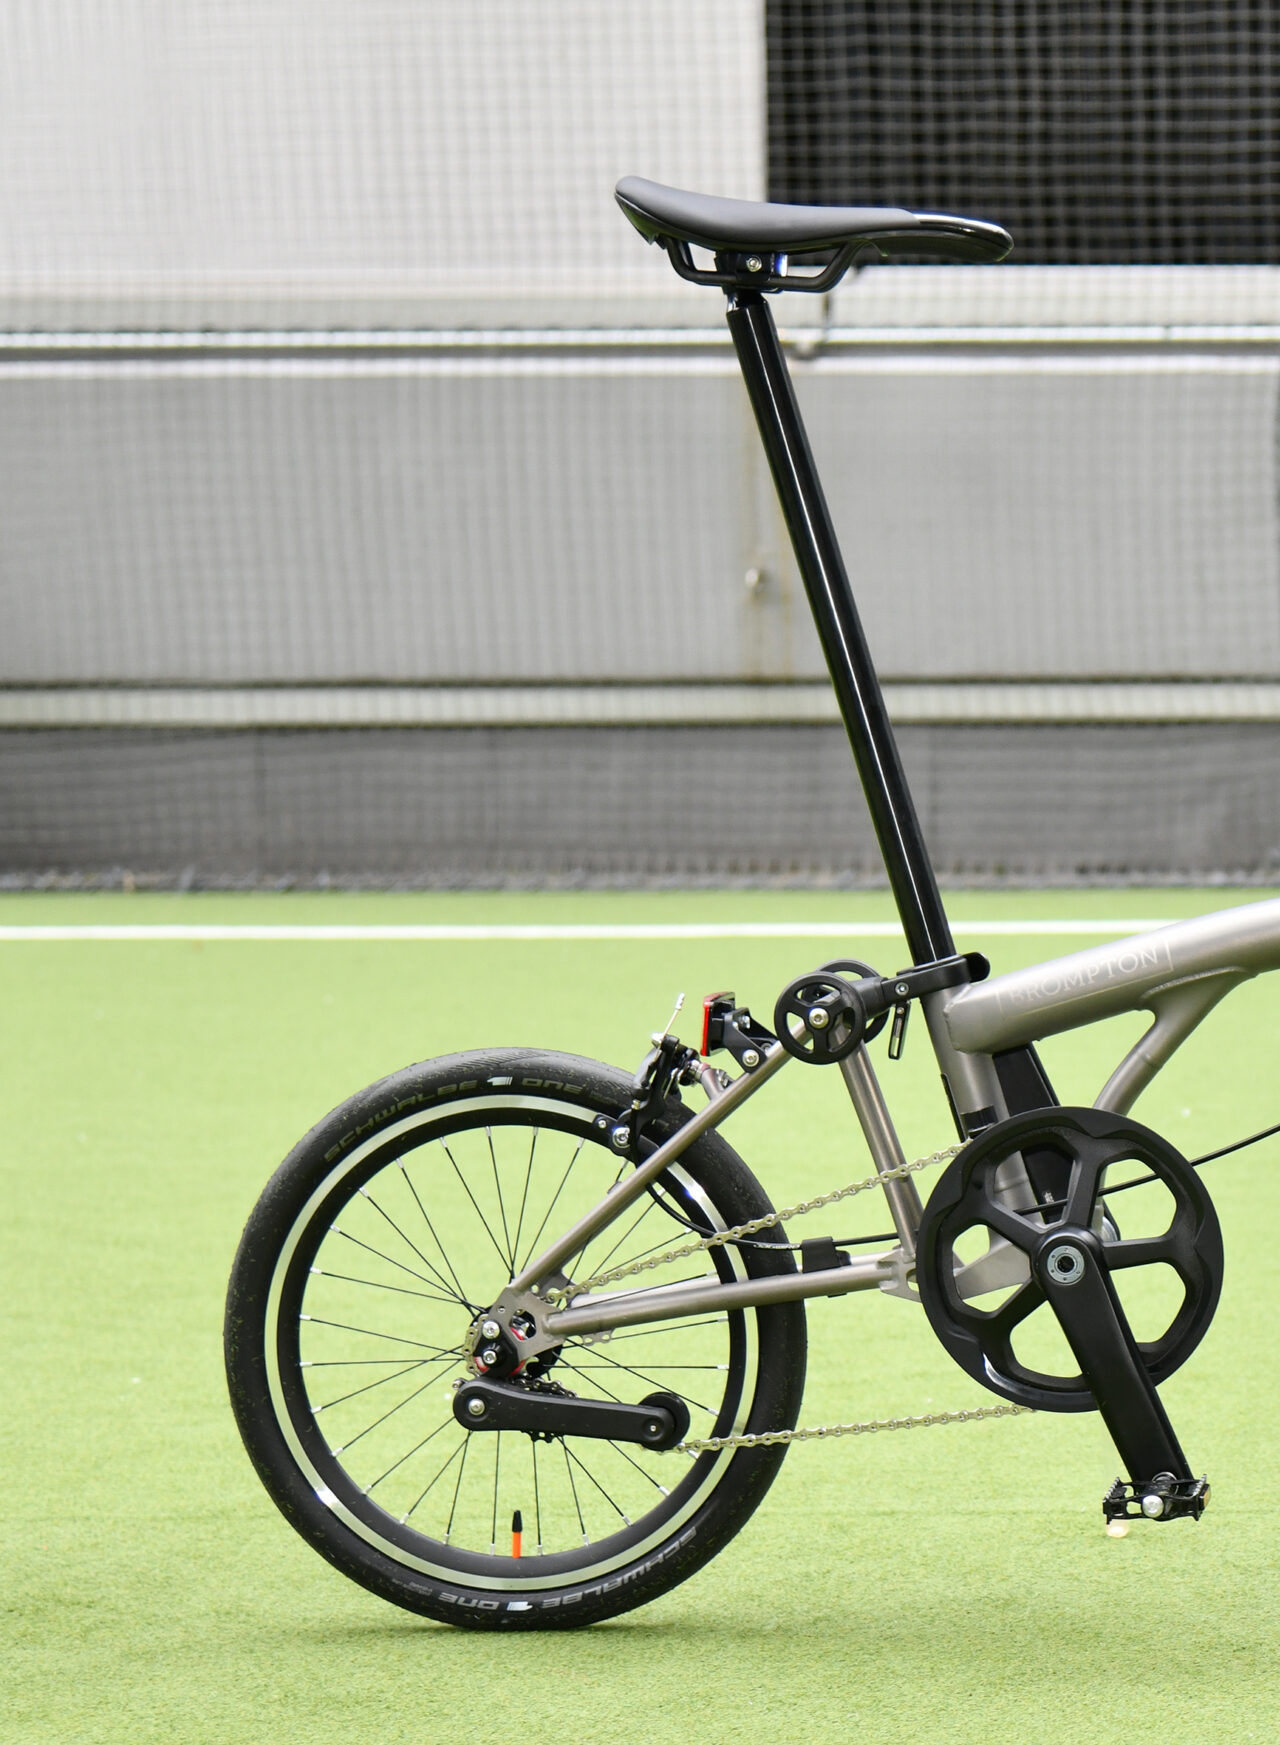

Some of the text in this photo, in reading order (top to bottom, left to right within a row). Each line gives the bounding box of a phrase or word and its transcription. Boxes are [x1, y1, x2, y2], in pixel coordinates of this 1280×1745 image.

[1008, 946, 1159, 1002] BROMPTON
[323, 1079, 479, 1163] SCHWALBE
[520, 1077, 584, 1095] ONE
[437, 1591, 501, 1611] ONE
[540, 1525, 698, 1609] SCHWALBE
